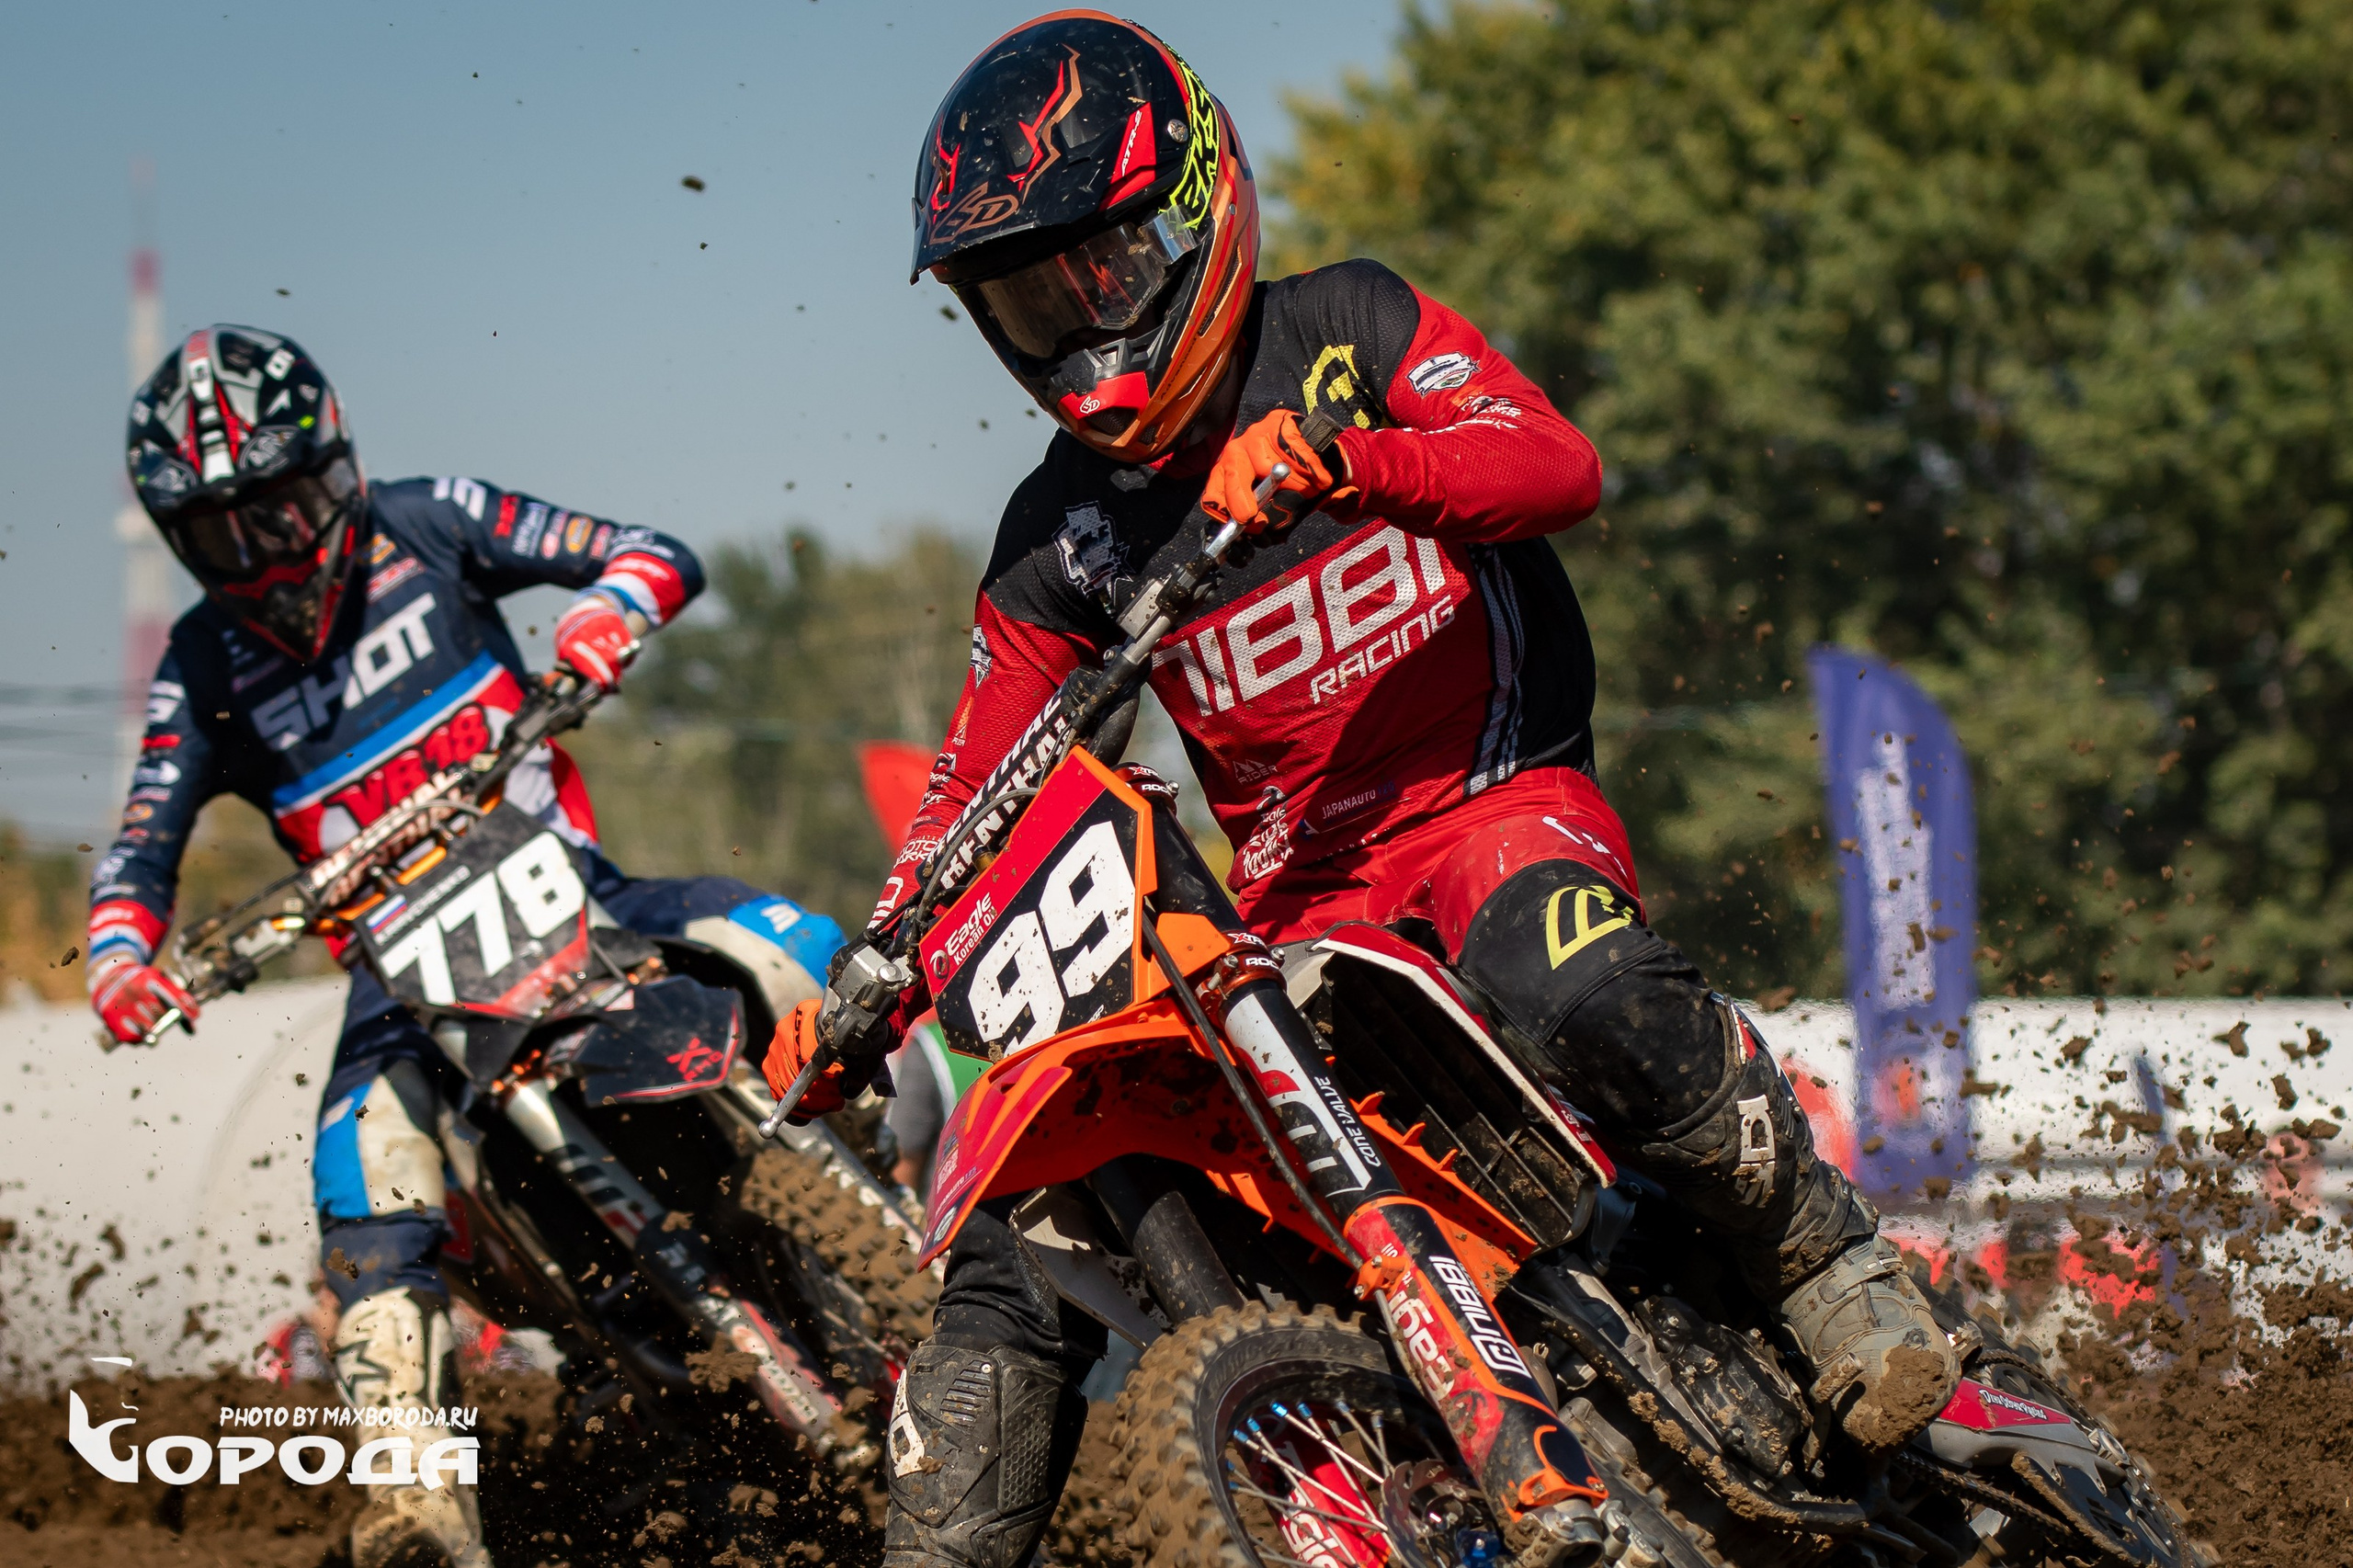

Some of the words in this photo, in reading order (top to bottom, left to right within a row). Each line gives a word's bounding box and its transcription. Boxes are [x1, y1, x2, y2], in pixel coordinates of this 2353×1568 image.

[250, 592, 437, 751] SHOT
[1310, 594, 1455, 705] RACING
[1129, 766, 1162, 778] XTR
[1237, 765, 1279, 784] RIDER
[1322, 789, 1377, 820] JAPANAUTO
[379, 830, 586, 1006] 778
[945, 892, 993, 958] Eagle
[968, 821, 1136, 1059] 99
[1227, 932, 1268, 950] XTR
[952, 922, 986, 967] Korean
[1245, 957, 1280, 971] ROC
[1314, 1076, 1357, 1125] VALVE
[1346, 1127, 1381, 1167] CONE
[1428, 1256, 1502, 1337] NIBBI
[1389, 1291, 1455, 1401] Eagl
